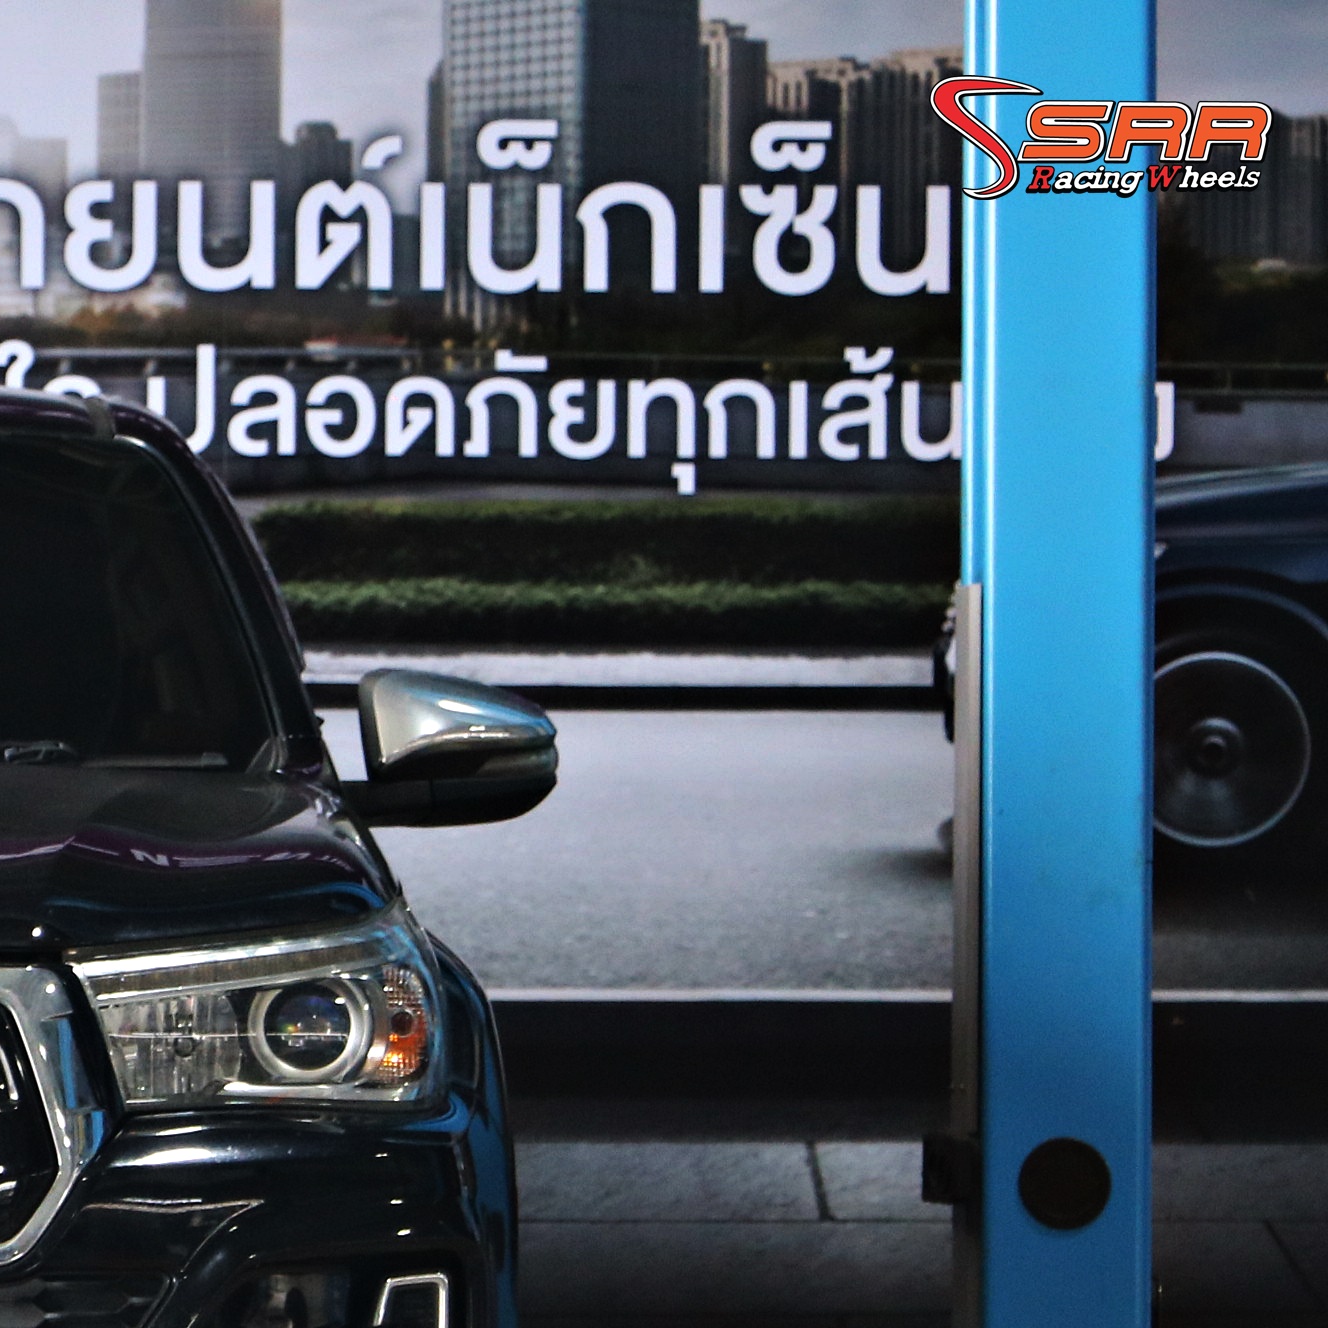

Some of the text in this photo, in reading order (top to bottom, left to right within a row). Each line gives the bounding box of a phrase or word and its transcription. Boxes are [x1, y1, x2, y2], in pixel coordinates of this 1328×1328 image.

[145, 342, 1175, 496] ปลอดภัยทุกเส้น
